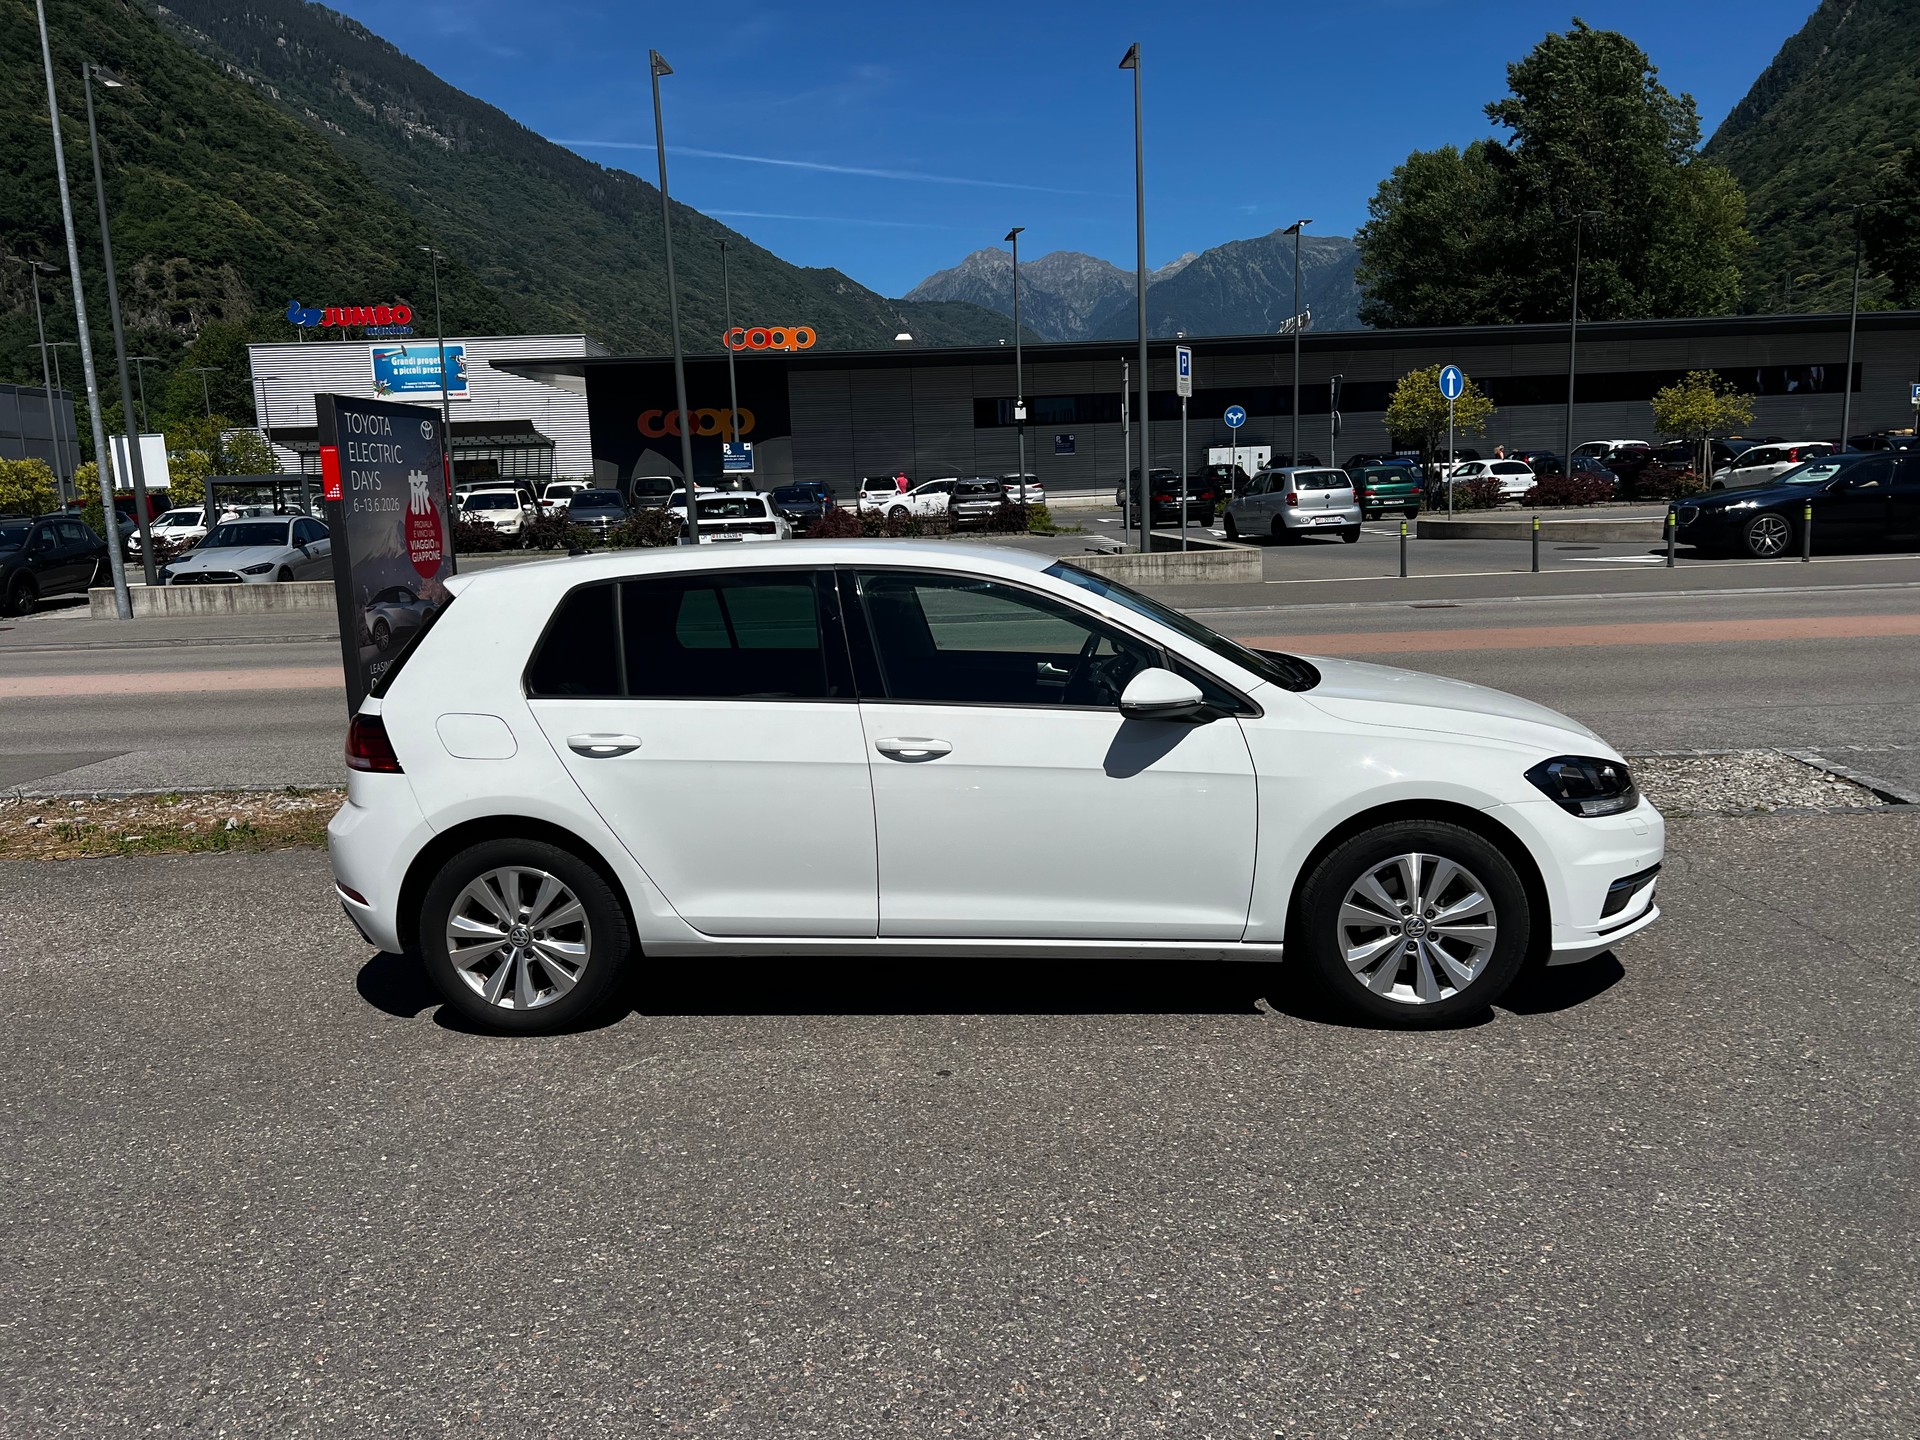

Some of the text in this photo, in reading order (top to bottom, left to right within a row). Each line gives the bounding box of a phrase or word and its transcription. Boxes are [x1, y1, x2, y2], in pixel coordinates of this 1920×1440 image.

[321, 305, 412, 327] JUMBO
[723, 326, 816, 351] coop
[391, 355, 446, 366] Grandi progeti
[1181, 355, 1187, 373] P
[399, 366, 421, 375] piccoli
[422, 366, 447, 375] prezz.
[344, 412, 392, 436] TOYOTA
[637, 408, 755, 442] coop
[348, 441, 403, 464] ELECTRIC
[351, 470, 382, 490] DAYS
[414, 520, 433, 529] PROVALA
[410, 539, 435, 550] VIAGGIO
[411, 550, 441, 562] GIAPPONE
